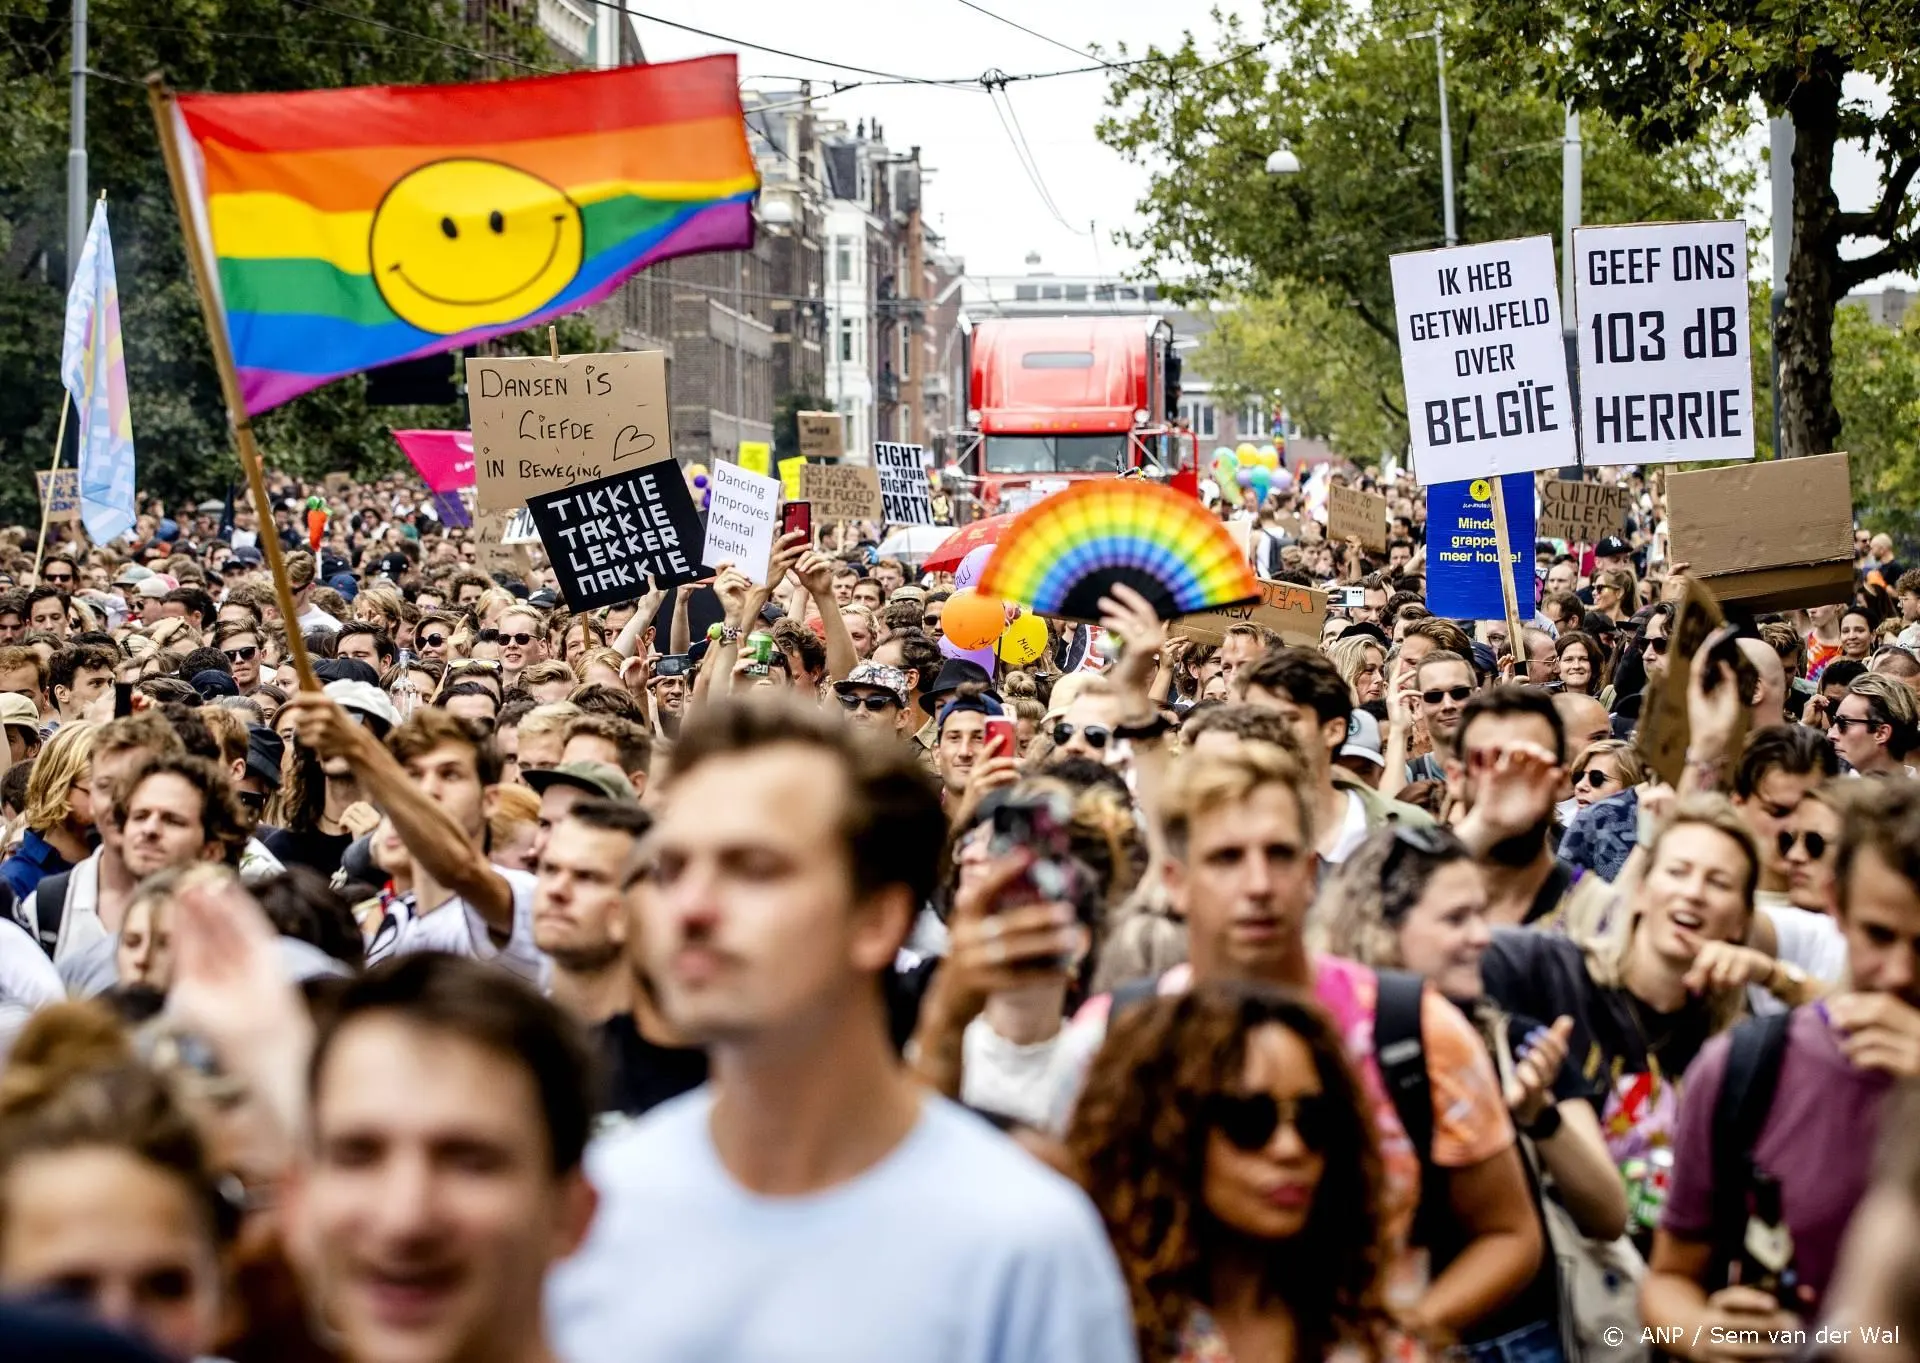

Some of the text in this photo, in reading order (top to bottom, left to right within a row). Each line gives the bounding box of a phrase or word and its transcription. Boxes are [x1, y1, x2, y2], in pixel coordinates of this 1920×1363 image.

[1438, 260, 1512, 296] IK HEB
[1588, 243, 1735, 285] GEEF ONS
[1409, 297, 1550, 341] GETWIJFELD
[1591, 306, 1737, 364] 103 dB
[1455, 343, 1516, 377] OVER
[480, 368, 567, 398] DANSEN
[1595, 388, 1741, 444] HERRIE
[875, 444, 921, 469] FIGHT
[717, 469, 765, 500] Dancing
[880, 478, 914, 494] RIGHT
[893, 467, 925, 481] YOUR
[547, 473, 661, 522] TIKKIE
[714, 490, 770, 521] Improves
[834, 489, 875, 504] FUCKED
[882, 494, 930, 525] PARTY
[1544, 480, 1630, 509] CULTURE
[558, 502, 671, 550] TAKKIE
[711, 511, 754, 537] Mental
[1458, 517, 1496, 530] Minde
[1541, 501, 1615, 526] KILLER
[568, 525, 680, 572] LEKKER
[708, 533, 748, 558] Health
[1440, 551, 1522, 563] meer houe!
[1451, 536, 1497, 549] grappe
